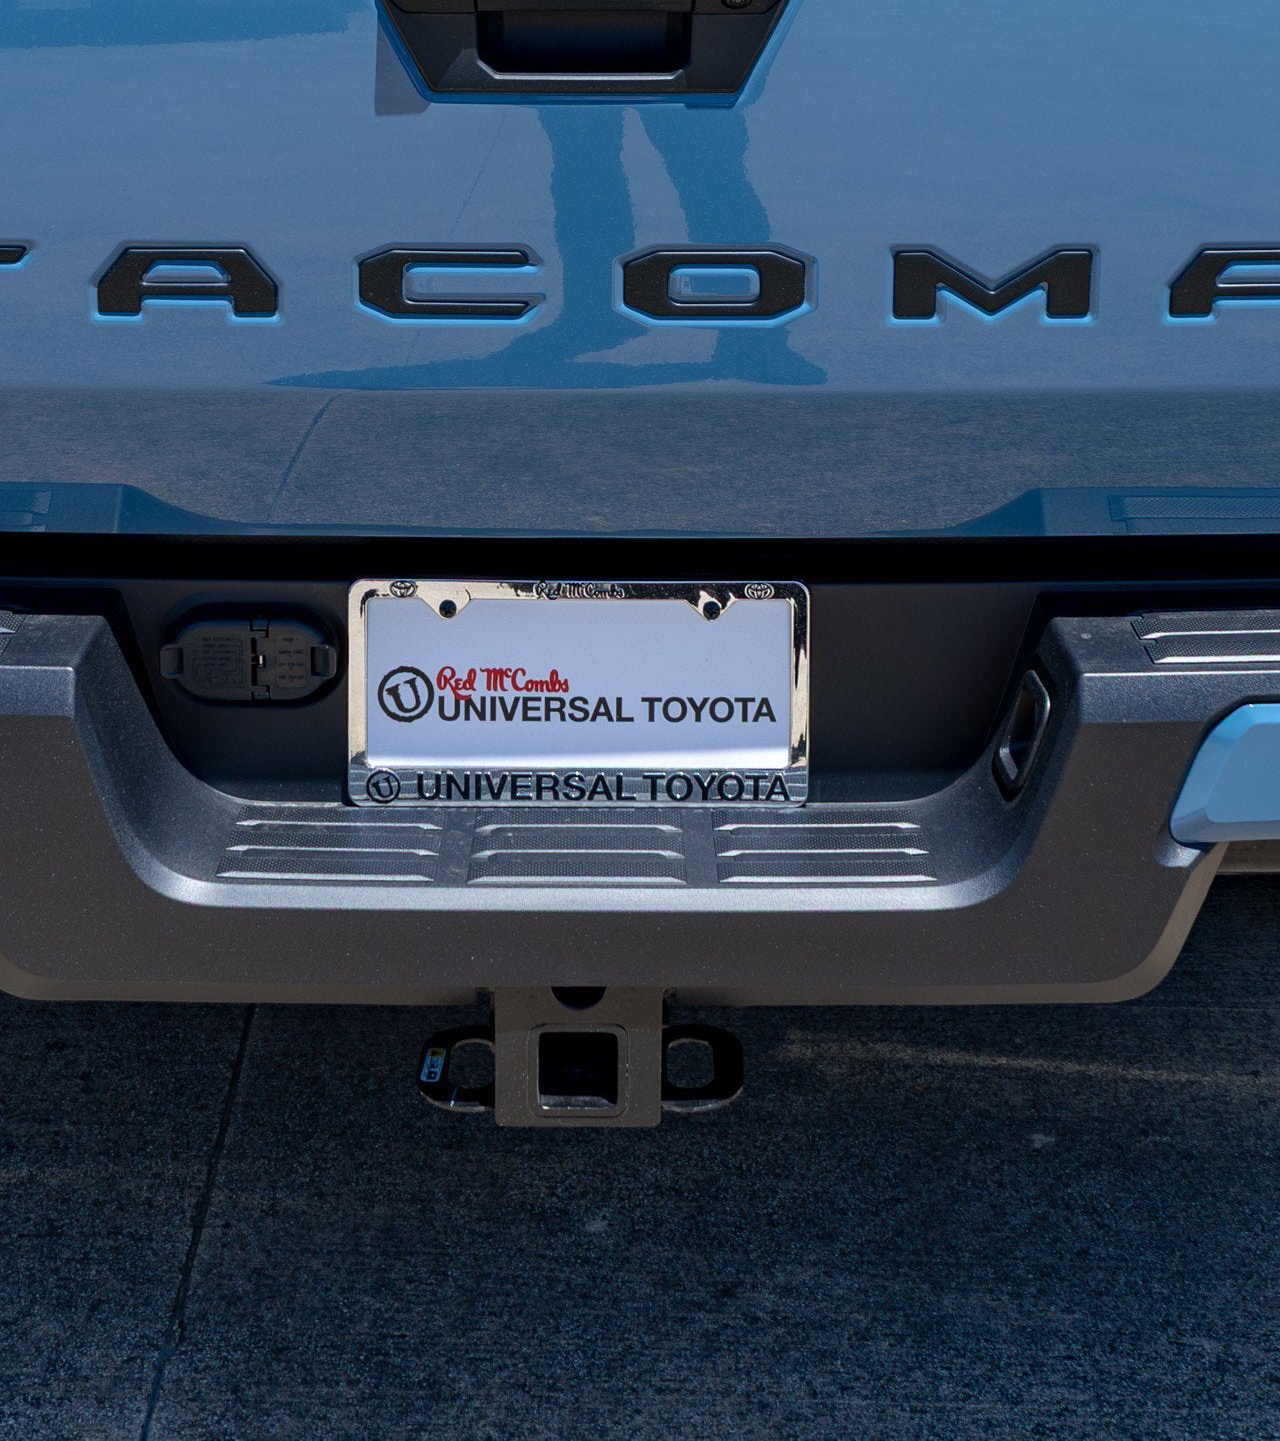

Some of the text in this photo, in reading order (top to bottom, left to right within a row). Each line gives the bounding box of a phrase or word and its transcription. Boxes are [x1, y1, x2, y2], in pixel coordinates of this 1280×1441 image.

[533, 580, 562, 600] Red
[436, 665, 570, 700] Red McCombs
[438, 695, 777, 723] UNIVERSAL TOYOTA
[417, 771, 792, 802] UNIVERSAL TOYOTA
